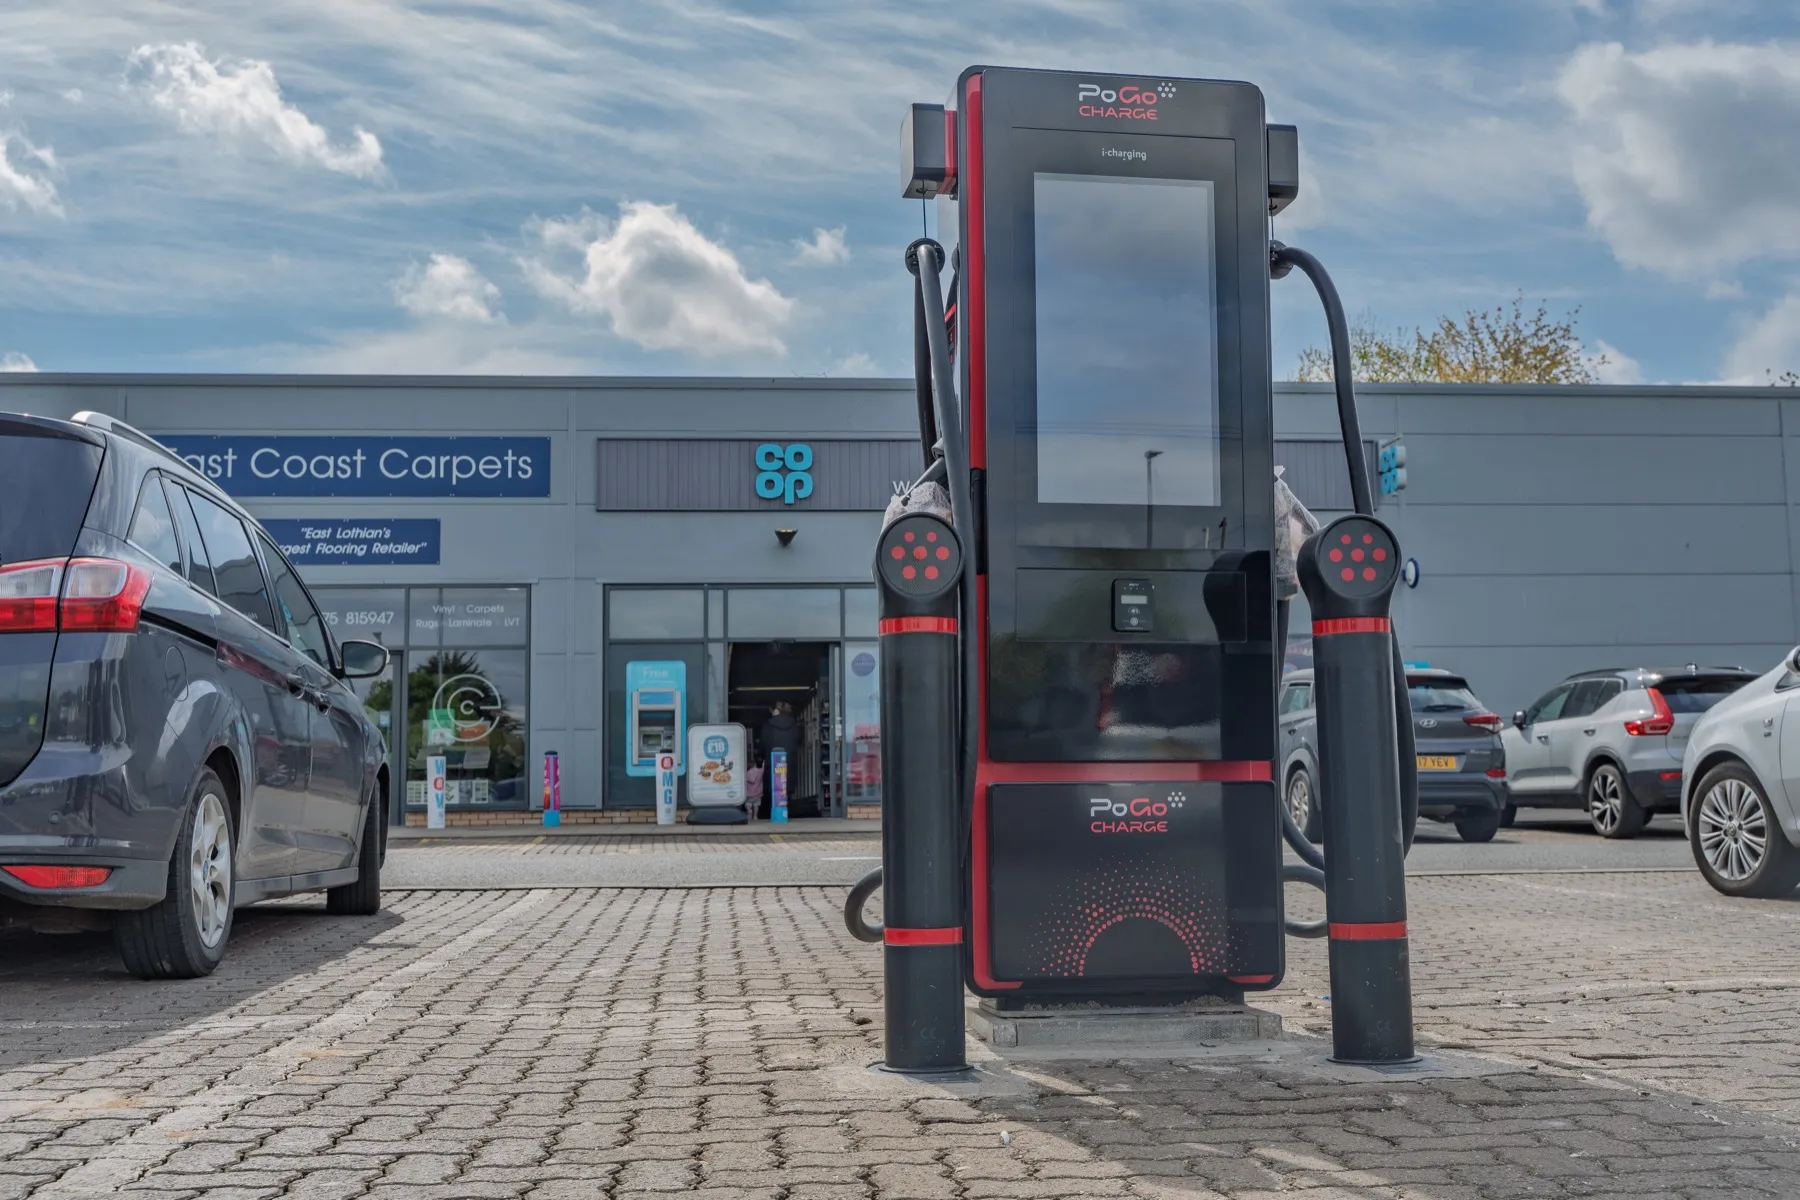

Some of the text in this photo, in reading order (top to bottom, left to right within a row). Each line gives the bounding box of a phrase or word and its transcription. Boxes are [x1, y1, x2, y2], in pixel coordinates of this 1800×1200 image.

[1078, 83, 1158, 105] PoGo
[1078, 105, 1158, 120] CHARGE
[1101, 147, 1147, 161] i-charging
[166, 447, 533, 485] ast Coast Carpets
[336, 527, 391, 539] Lothian's
[315, 543, 367, 557] Flooring
[432, 604, 505, 615] Vinyl Carpets
[345, 611, 394, 626] 815947
[415, 617, 520, 629] Rugs Laminate LVT
[1090, 797, 1168, 817] PoGo
[1090, 820, 1168, 833] CHARGE
